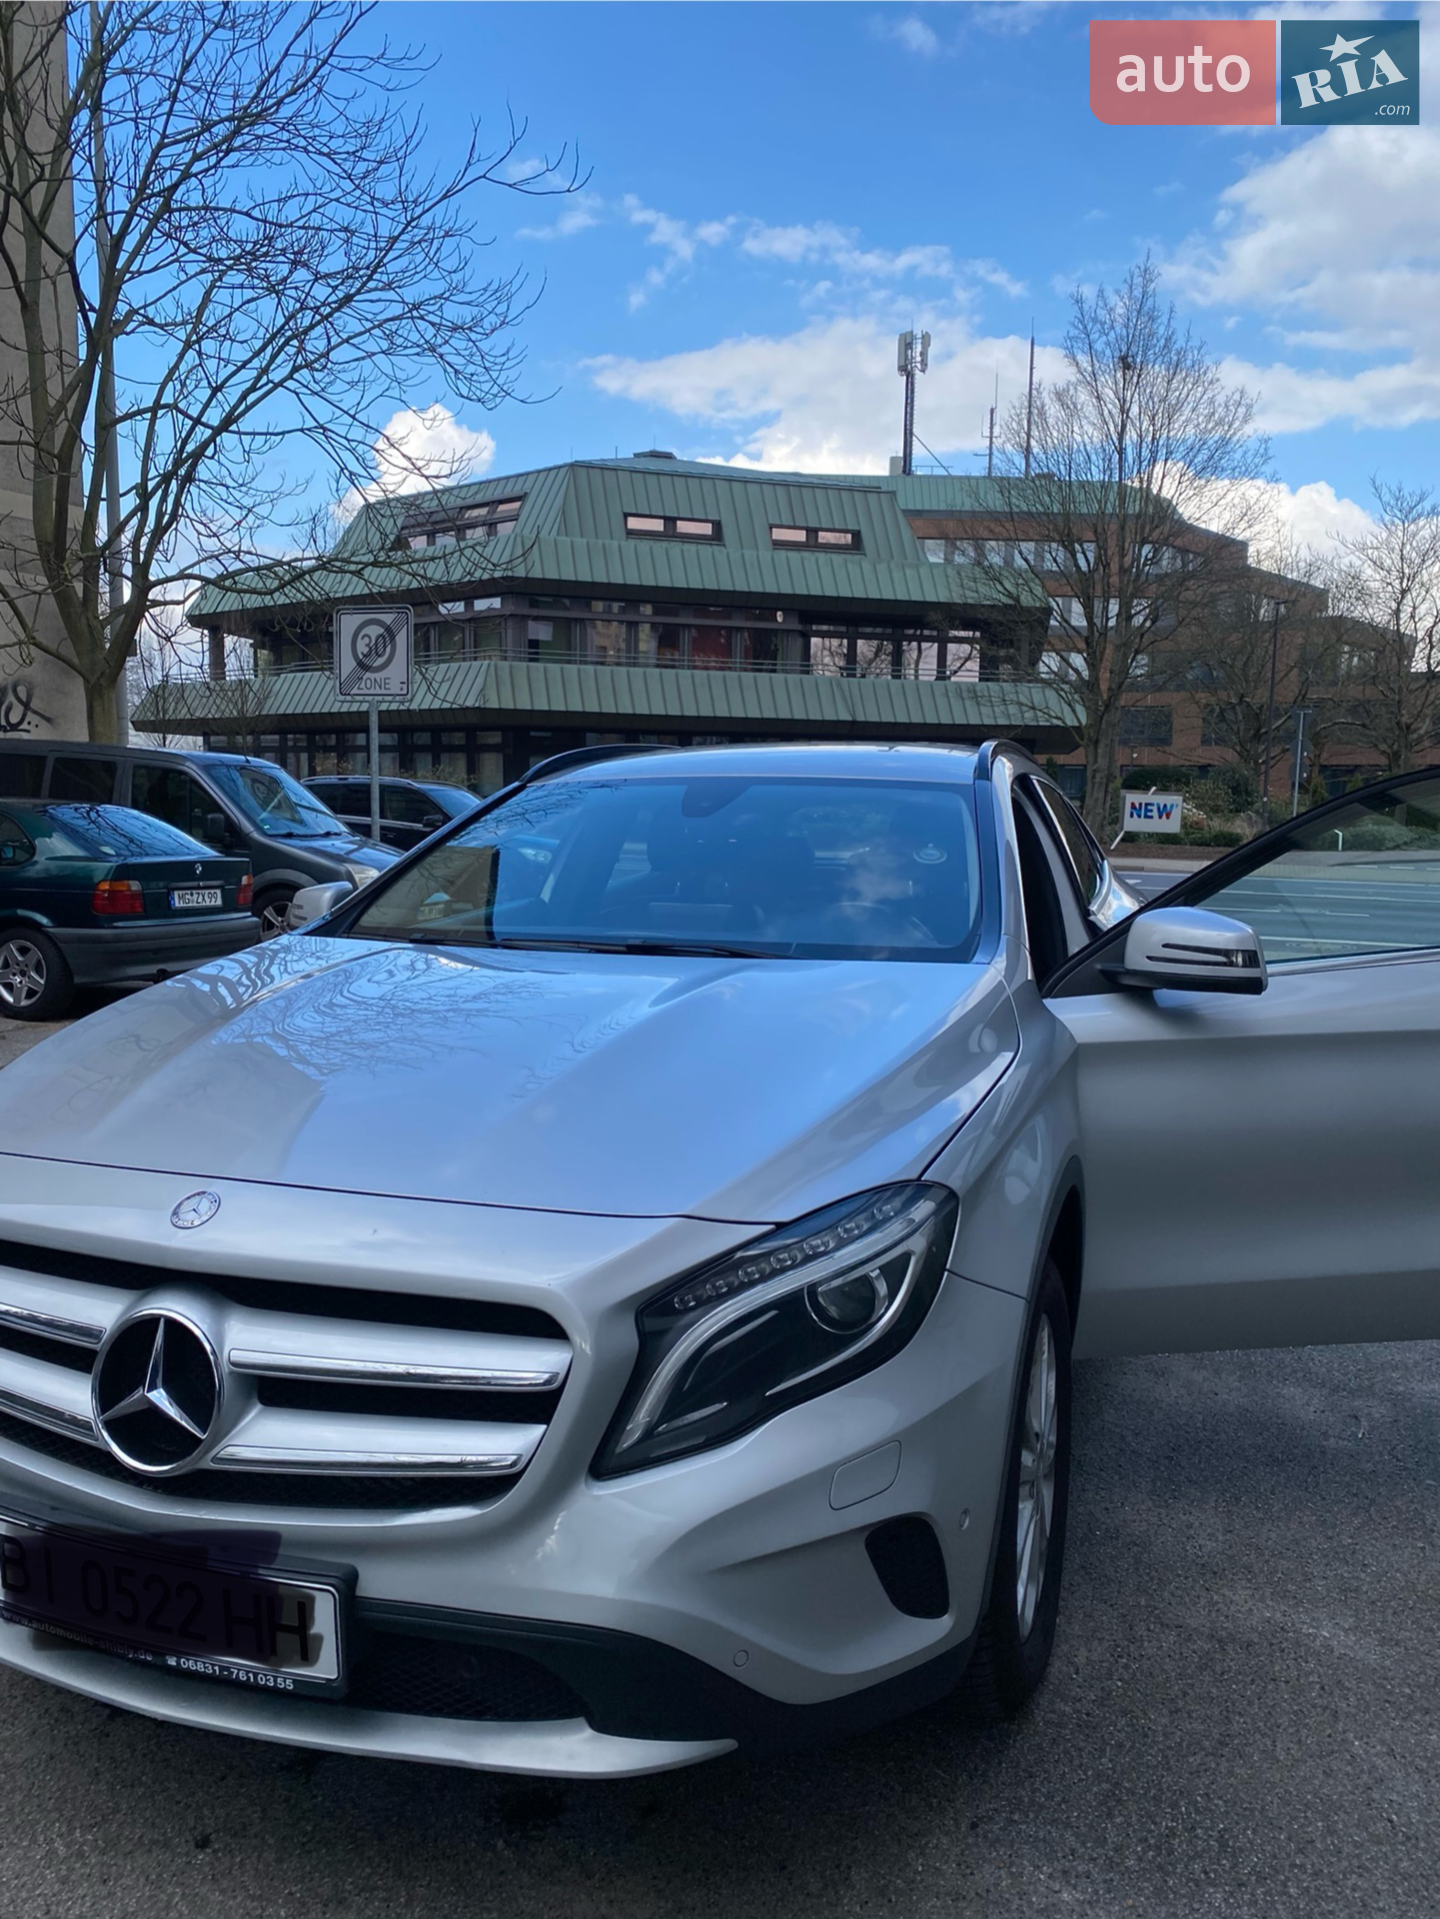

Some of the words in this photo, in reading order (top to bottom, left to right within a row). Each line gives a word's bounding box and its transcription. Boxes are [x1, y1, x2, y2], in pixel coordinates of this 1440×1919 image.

[361, 633, 387, 658] 30
[357, 677, 391, 691] ZONE
[178, 891, 191, 905] MG
[80, 1559, 207, 1642] 0522
[222, 1588, 309, 1662] HH
[180, 1658, 219, 1675] 06831
